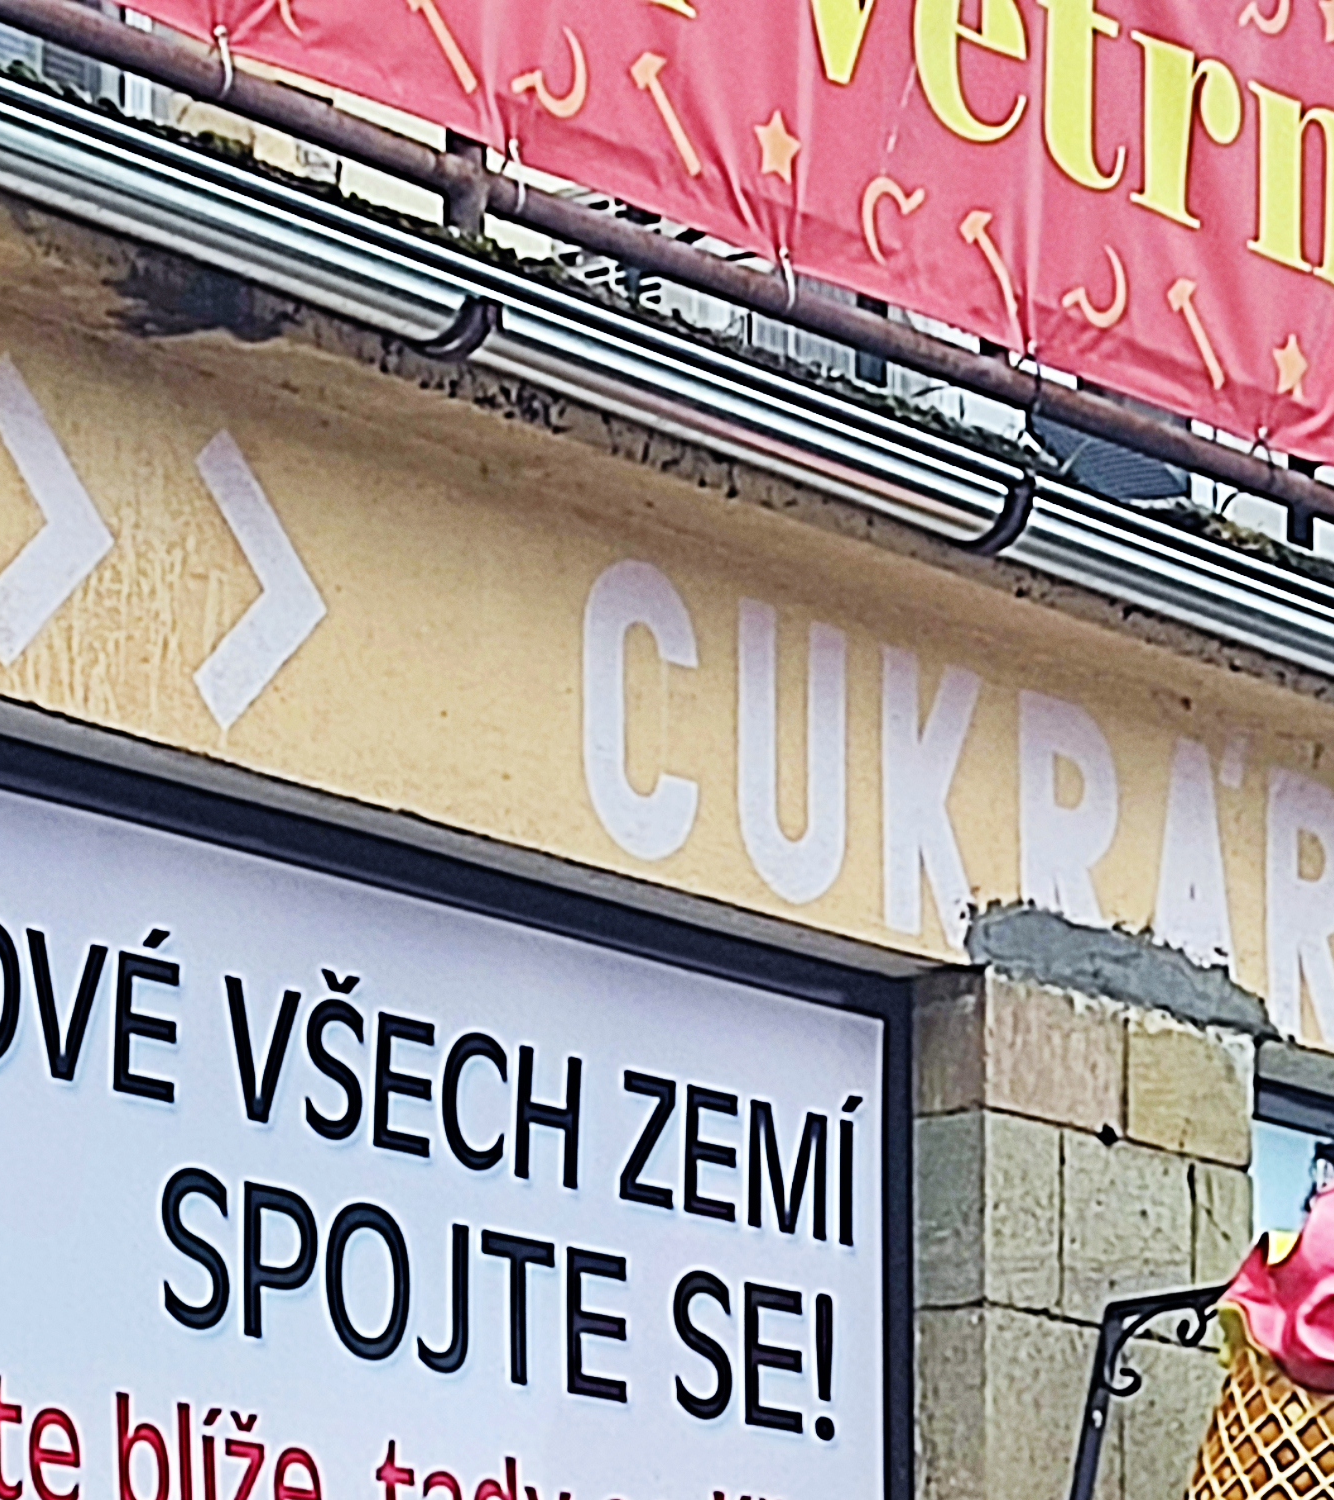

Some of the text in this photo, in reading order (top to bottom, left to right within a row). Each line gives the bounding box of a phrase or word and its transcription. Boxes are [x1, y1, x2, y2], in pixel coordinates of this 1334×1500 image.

[224, 968, 583, 1190] VŠECH
[618, 1068, 864, 1248] ZEMÍ
[160, 1166, 836, 1442] SPOJTE SE!
